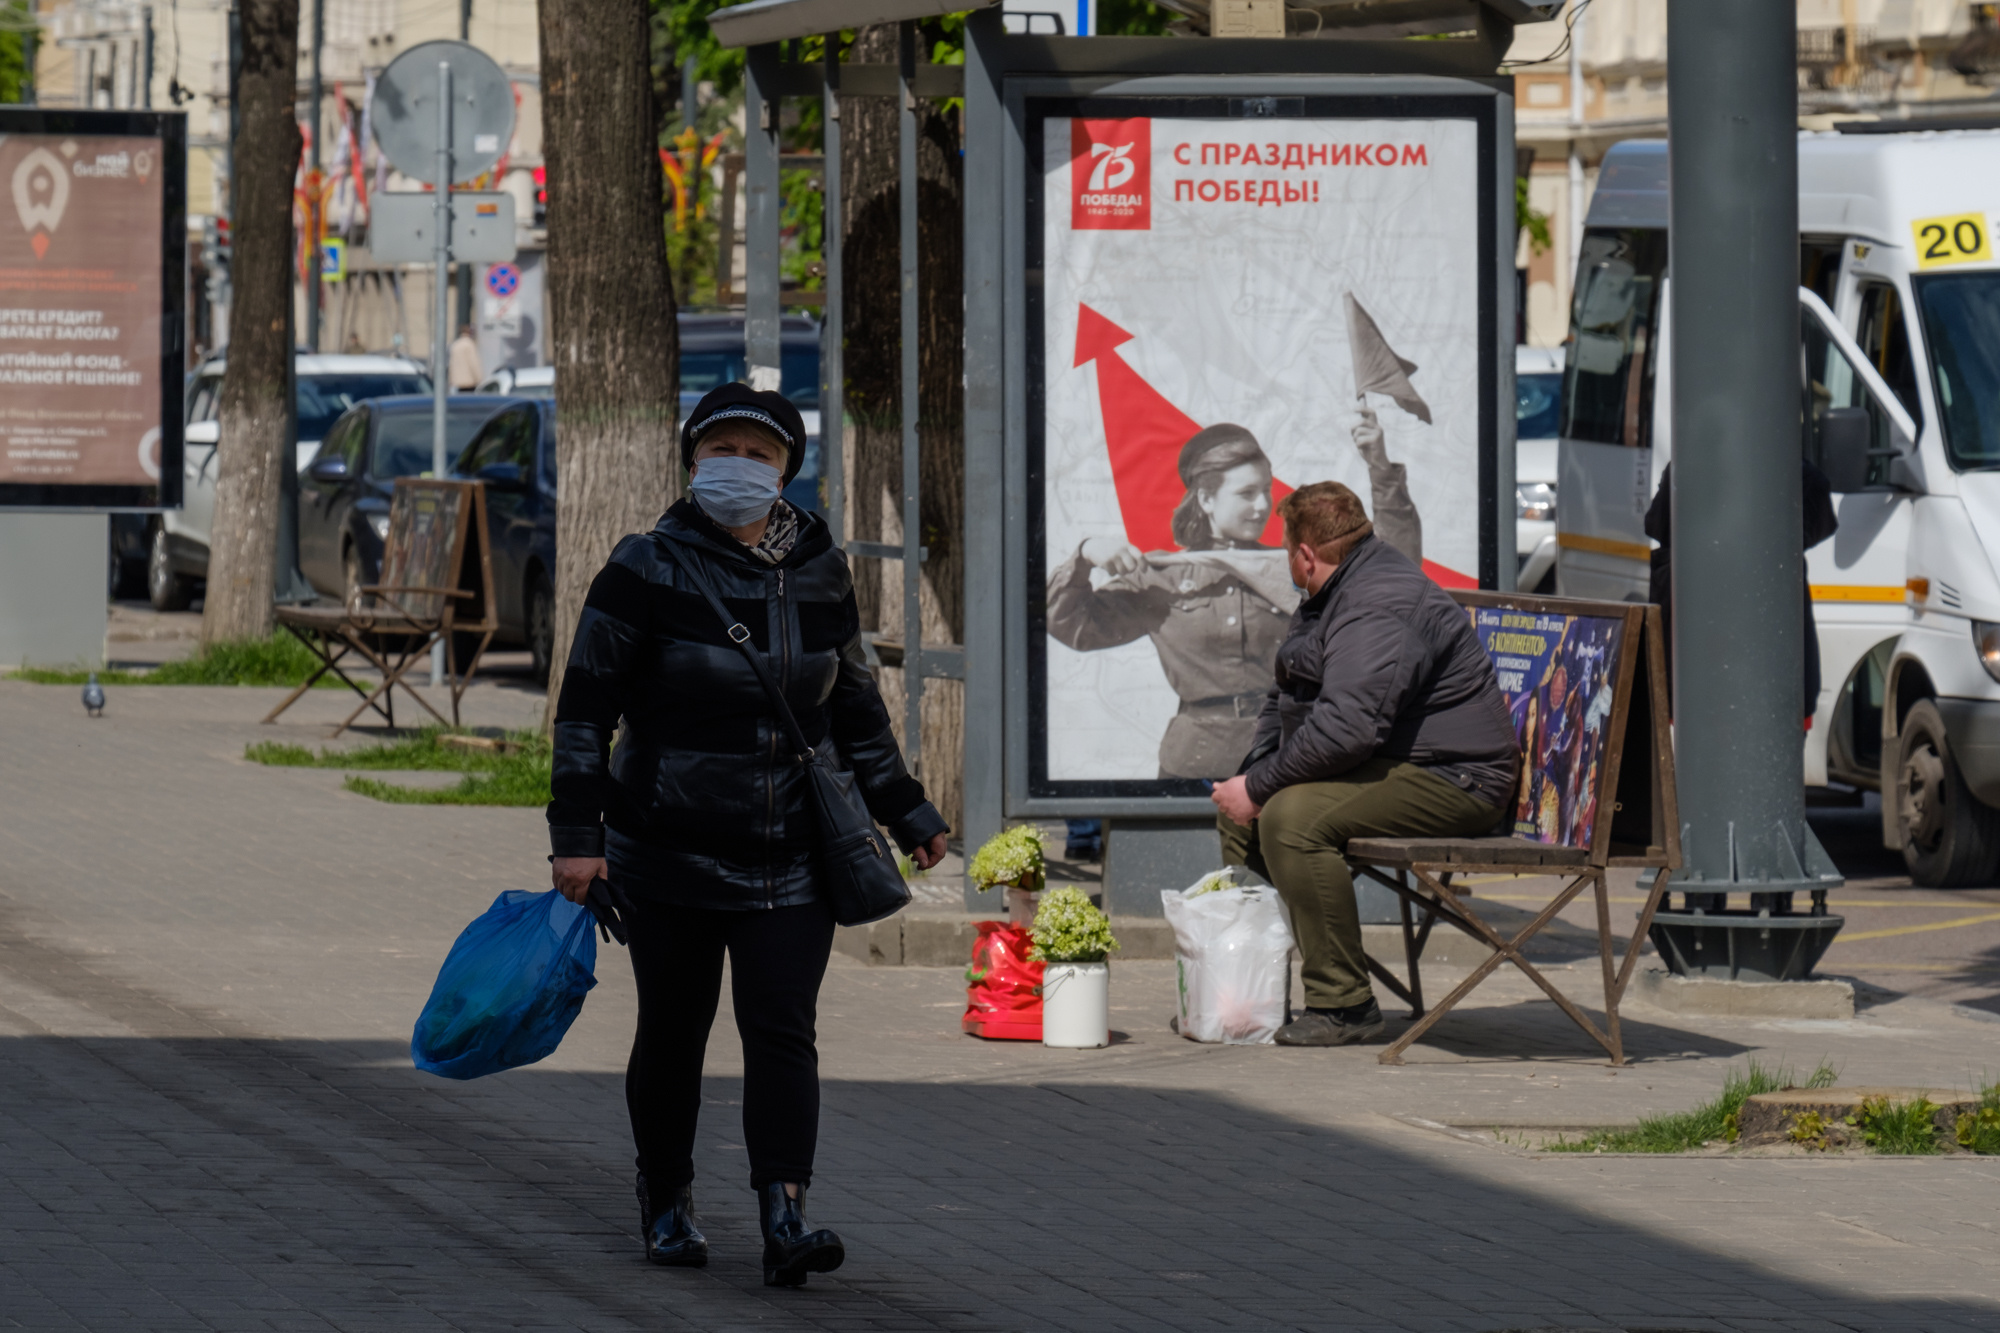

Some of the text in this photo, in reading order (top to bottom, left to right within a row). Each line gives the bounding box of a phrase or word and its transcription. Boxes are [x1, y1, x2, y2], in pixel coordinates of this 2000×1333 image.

[1173, 143, 1428, 171] С ПРАЗДНИКОМ
[1088, 141, 1135, 191] 75
[1080, 194, 1142, 208] ПОБЕДА!
[1174, 179, 1320, 207] ПОБЕДЫ!
[1920, 220, 1982, 260] 20
[0, 309, 103, 325] РЕТЕ КРЕДИТ?
[55, 327, 119, 341] ЗАЛОГА?
[75, 355, 121, 370] ФОНД
[66, 371, 142, 385] РЕШЕНИЕ!
